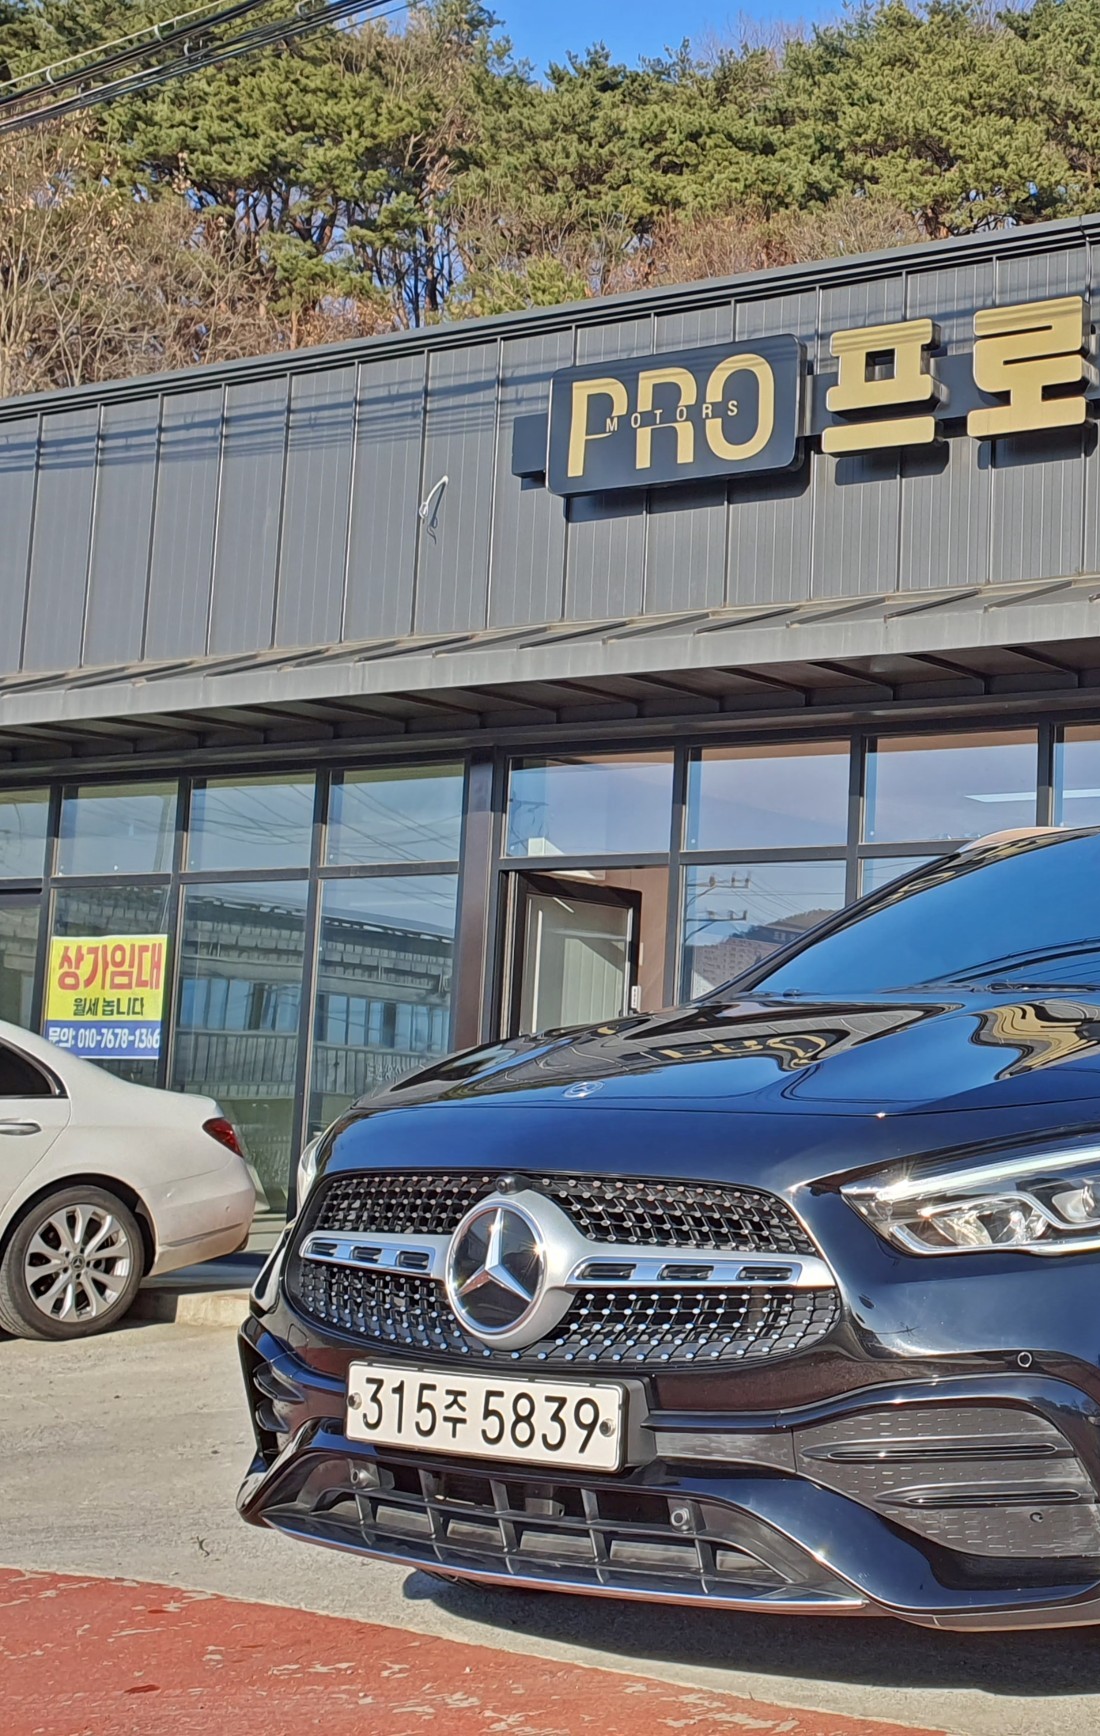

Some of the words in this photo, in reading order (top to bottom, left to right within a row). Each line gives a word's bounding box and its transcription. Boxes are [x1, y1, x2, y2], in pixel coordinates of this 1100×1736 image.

[567, 352, 775, 478] PRO
[605, 399, 739, 433] MOTORS
[57, 943, 162, 990] 상가임대
[73, 997, 100, 1017] 월세
[102, 996, 144, 1017] 놉니다
[78, 1028, 160, 1049] 010-7678-1366
[362, 1376, 468, 1439] 315주
[480, 1389, 601, 1455] 5839
